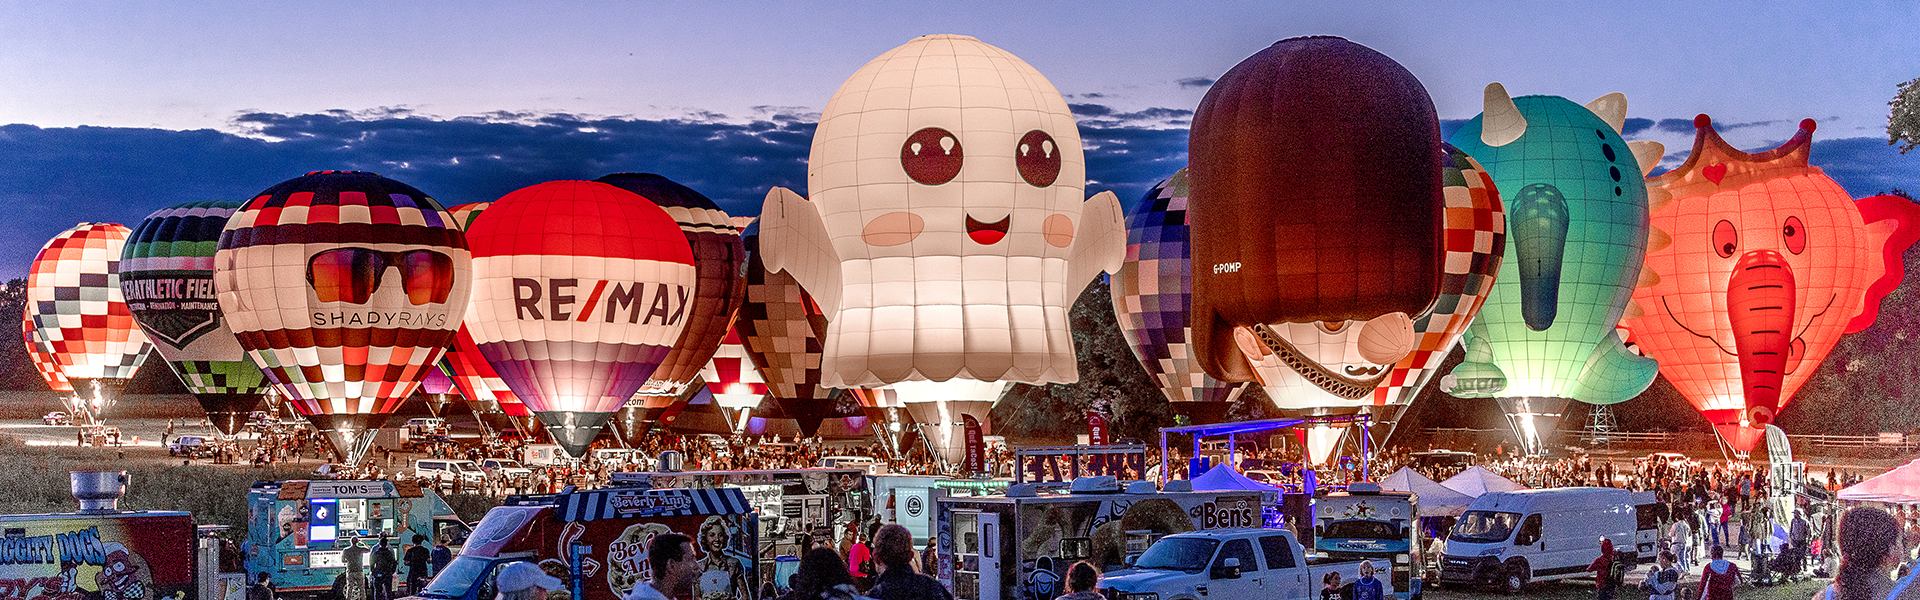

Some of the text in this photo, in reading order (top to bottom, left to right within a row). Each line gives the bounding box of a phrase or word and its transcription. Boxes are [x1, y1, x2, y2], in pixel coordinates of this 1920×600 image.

[1213, 262, 1242, 274] G-POMP
[186, 278, 217, 299] FIEL
[181, 302, 218, 310] MAINTENANCE
[513, 277, 690, 327] RE/MAX
[332, 485, 368, 494] TOM'S
[610, 494, 692, 509] Beverly Ann's
[56, 526, 106, 566] DOGS
[610, 533, 653, 561] Bev
[622, 558, 651, 579] An
